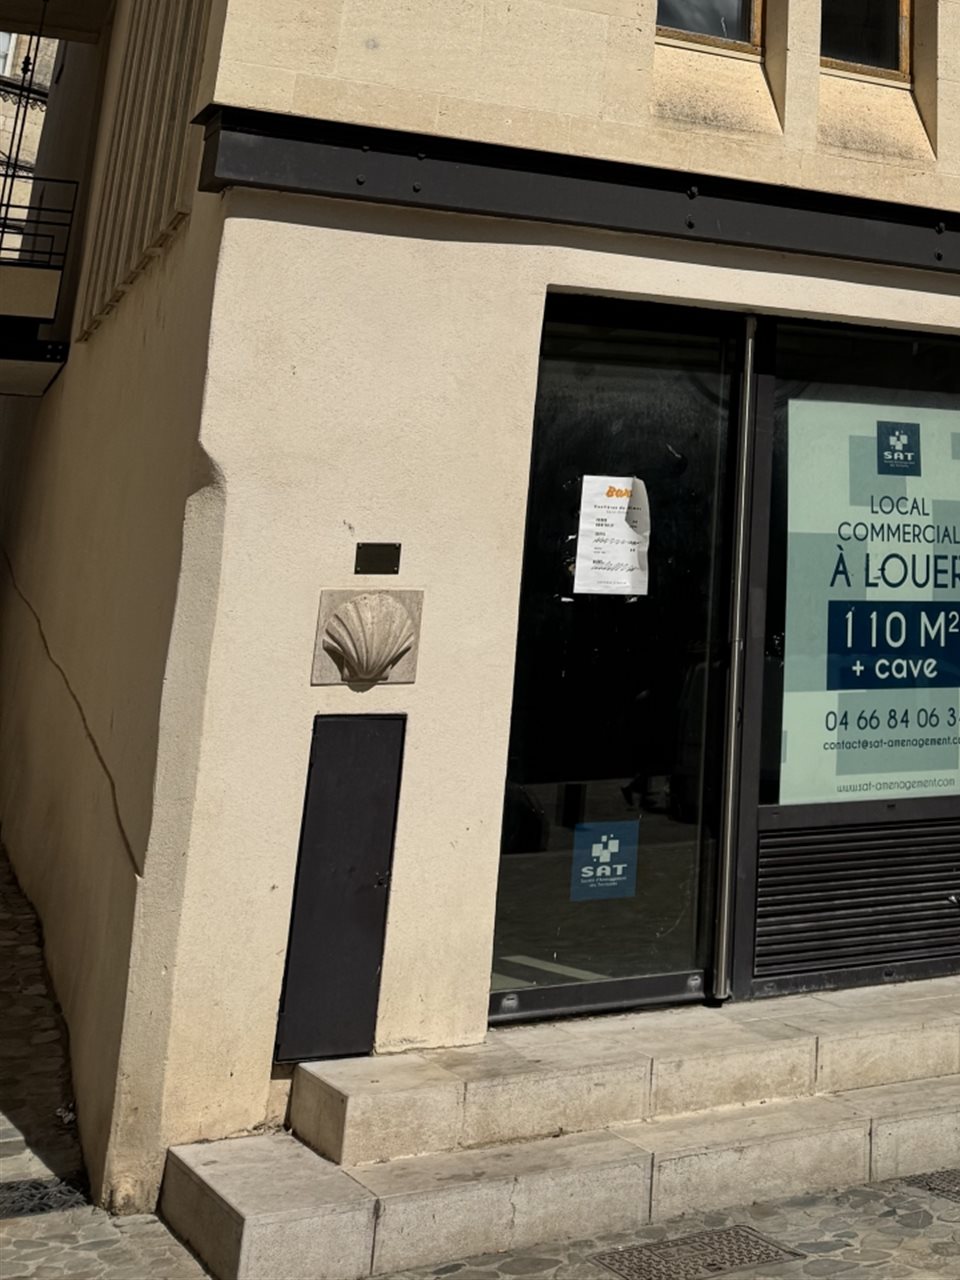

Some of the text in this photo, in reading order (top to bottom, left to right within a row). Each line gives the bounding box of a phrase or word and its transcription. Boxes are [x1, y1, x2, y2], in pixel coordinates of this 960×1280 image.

[883, 451, 915, 460] SAT
[870, 495, 930, 516] LOCAL
[837, 521, 960, 544] COMMERCIAL
[829, 543, 851, 588] À
[845, 610, 907, 648] 110
[875, 658, 938, 679] cave
[825, 710, 849, 732] 04
[856, 708, 881, 731] 66
[887, 708, 910, 730] 84
[917, 707, 940, 729] 06
[581, 864, 628, 878] SAT
